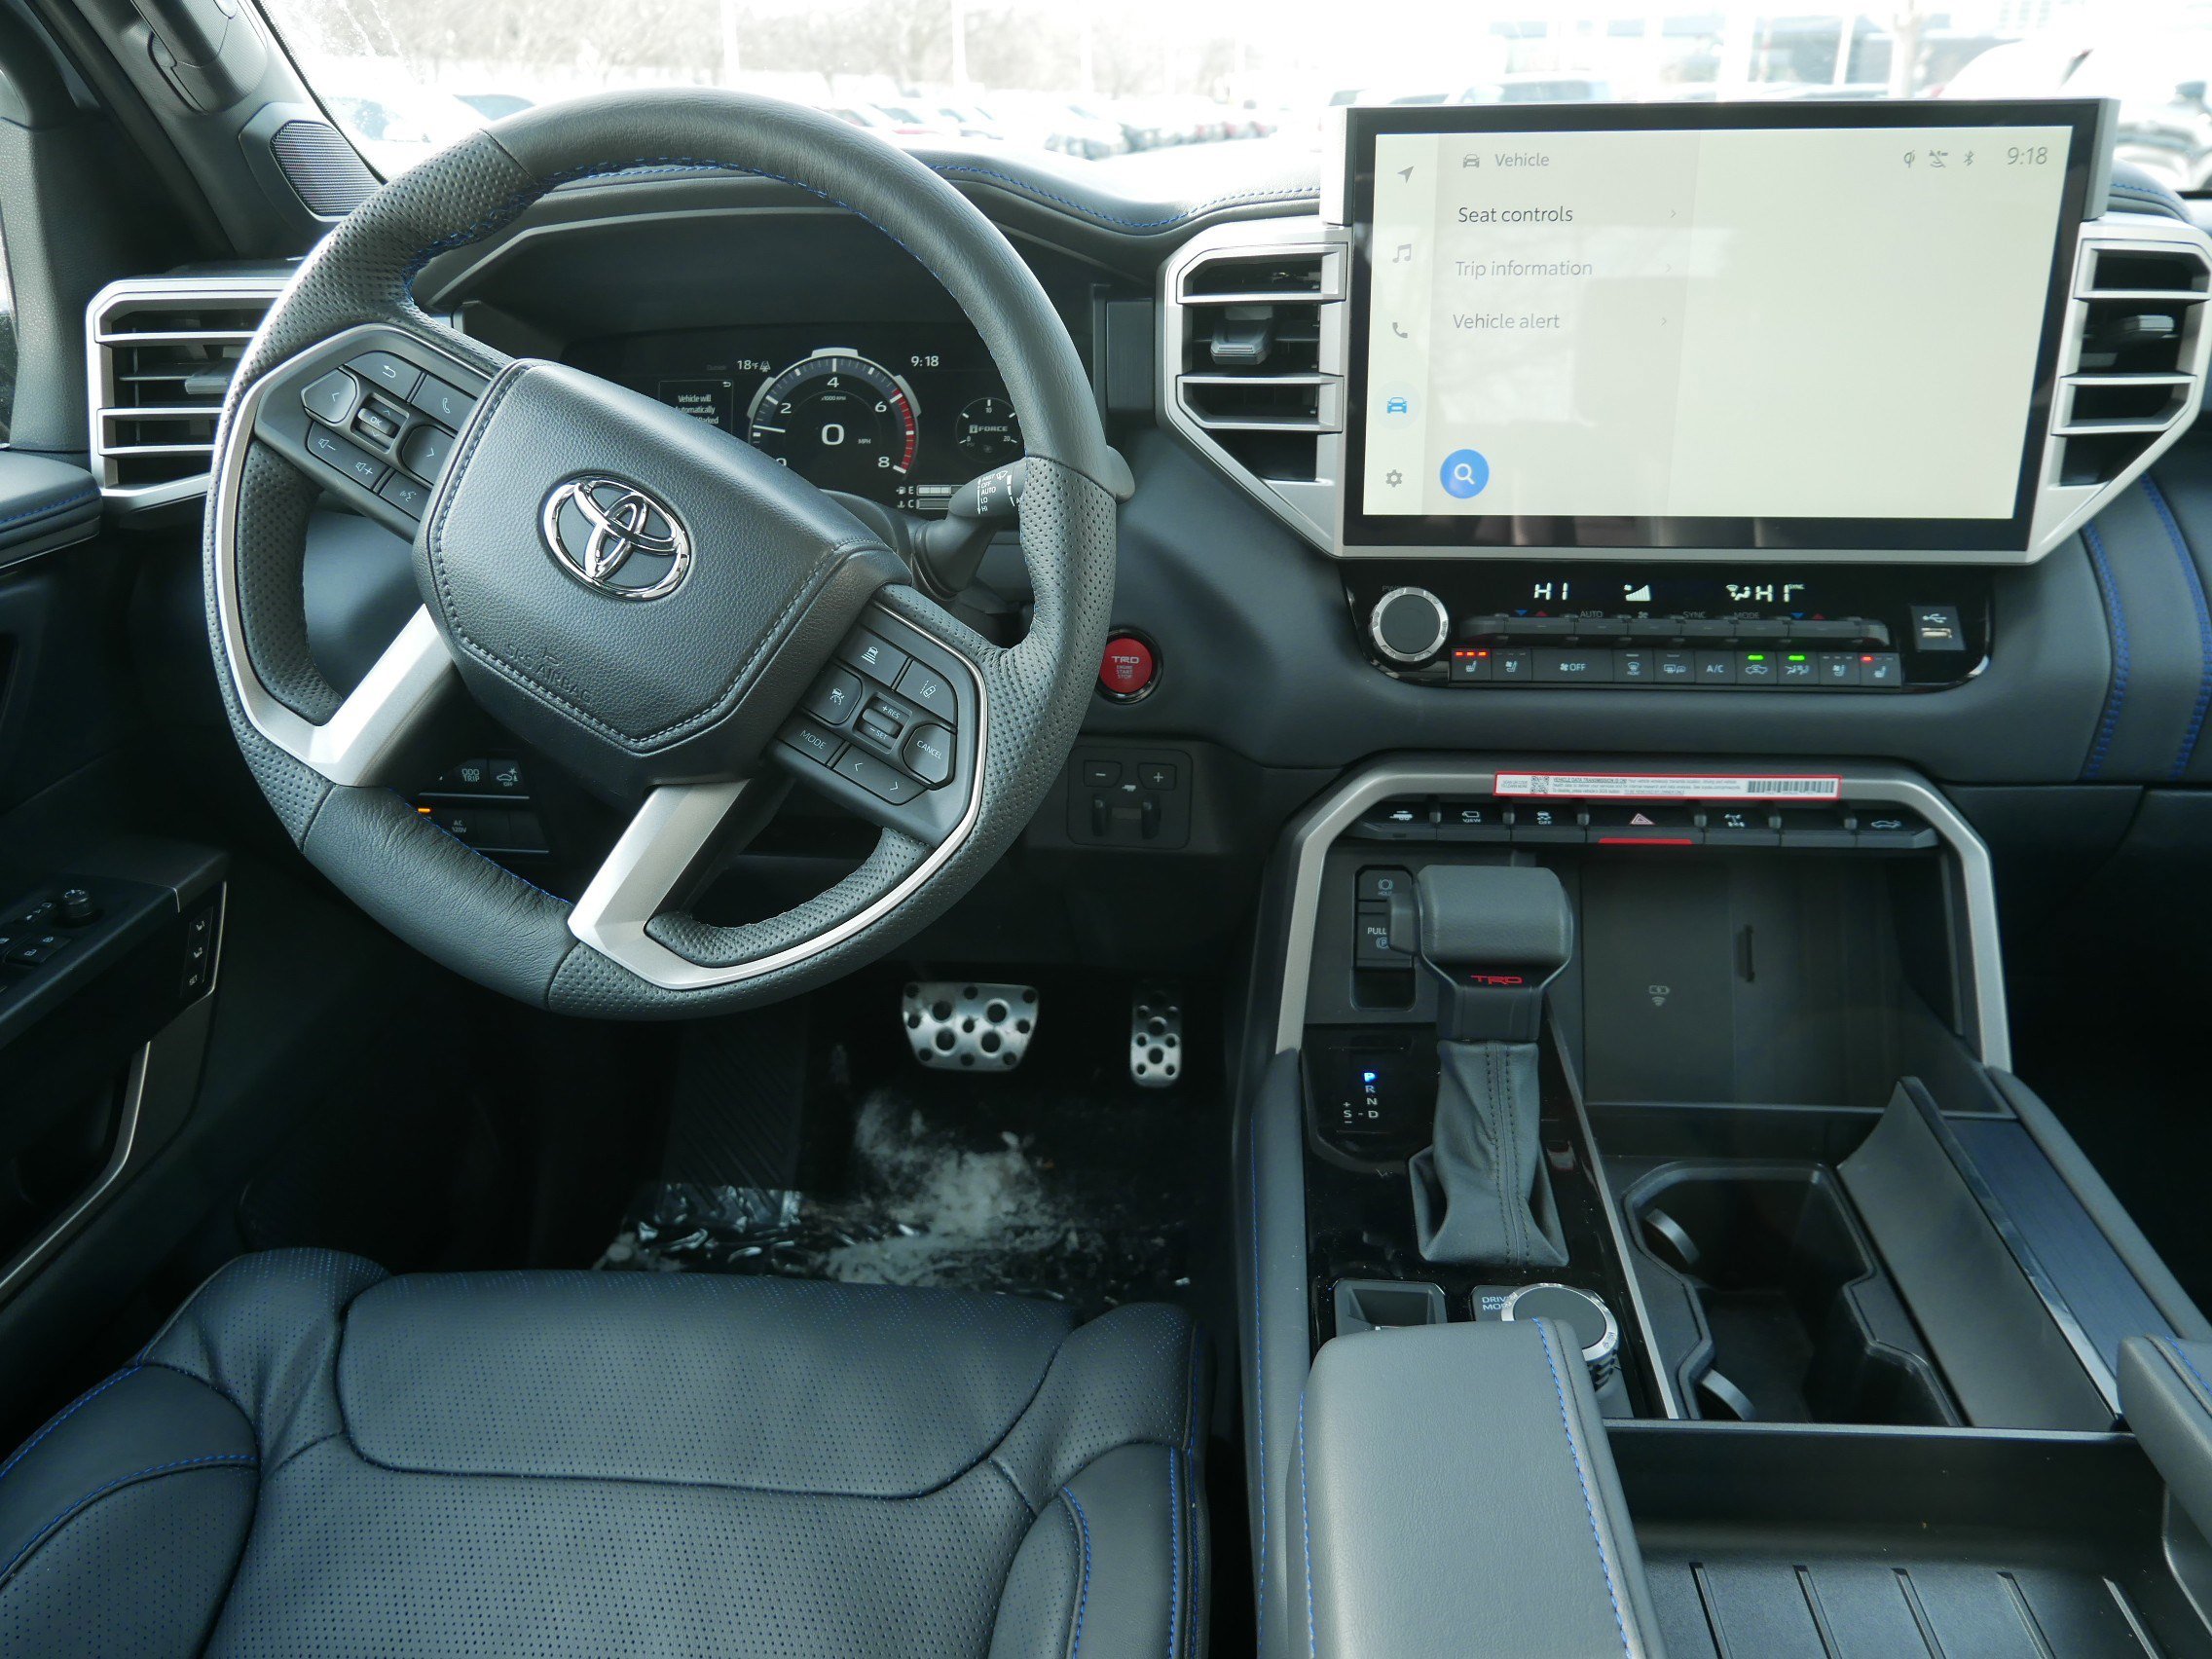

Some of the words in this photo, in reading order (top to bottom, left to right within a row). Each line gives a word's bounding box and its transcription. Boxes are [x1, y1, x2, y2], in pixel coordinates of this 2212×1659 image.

[1494, 152, 1550, 167] Vehicle
[2007, 146, 2048, 166] 9:18
[1457, 206, 1497, 223] Seat
[1501, 205, 1573, 223] controls
[1456, 260, 1487, 279] Trip
[1491, 259, 1593, 276] information
[1453, 313, 1515, 329] Vehicle
[1519, 313, 1560, 329] alert
[910, 355, 940, 367] 9:18
[827, 377, 839, 388] 4
[780, 402, 792, 414] 2
[874, 400, 887, 413] 6
[370, 415, 384, 428] OK
[821, 424, 845, 446] 0
[877, 456, 890, 468] 8
[980, 480, 992, 489] OFF
[980, 486, 997, 496] AUTO
[907, 499, 914, 508] C
[1532, 581, 1570, 602] HI
[1579, 609, 1604, 619] AUTO
[1682, 610, 1707, 619] SYNC
[1733, 611, 1760, 620] MODE
[1111, 655, 1140, 664] TRD
[1568, 662, 1586, 672] OFF
[1706, 664, 1724, 674] A/C
[799, 729, 826, 750] MODE
[916, 740, 942, 759] CANCEL
[1470, 975, 1525, 985] TRD
[1364, 1072, 1376, 1083] P
[1365, 1085, 1376, 1093] R
[1366, 1097, 1379, 1106] N
[1368, 1110, 1380, 1119] D
[1481, 1296, 1508, 1305] DRIV
